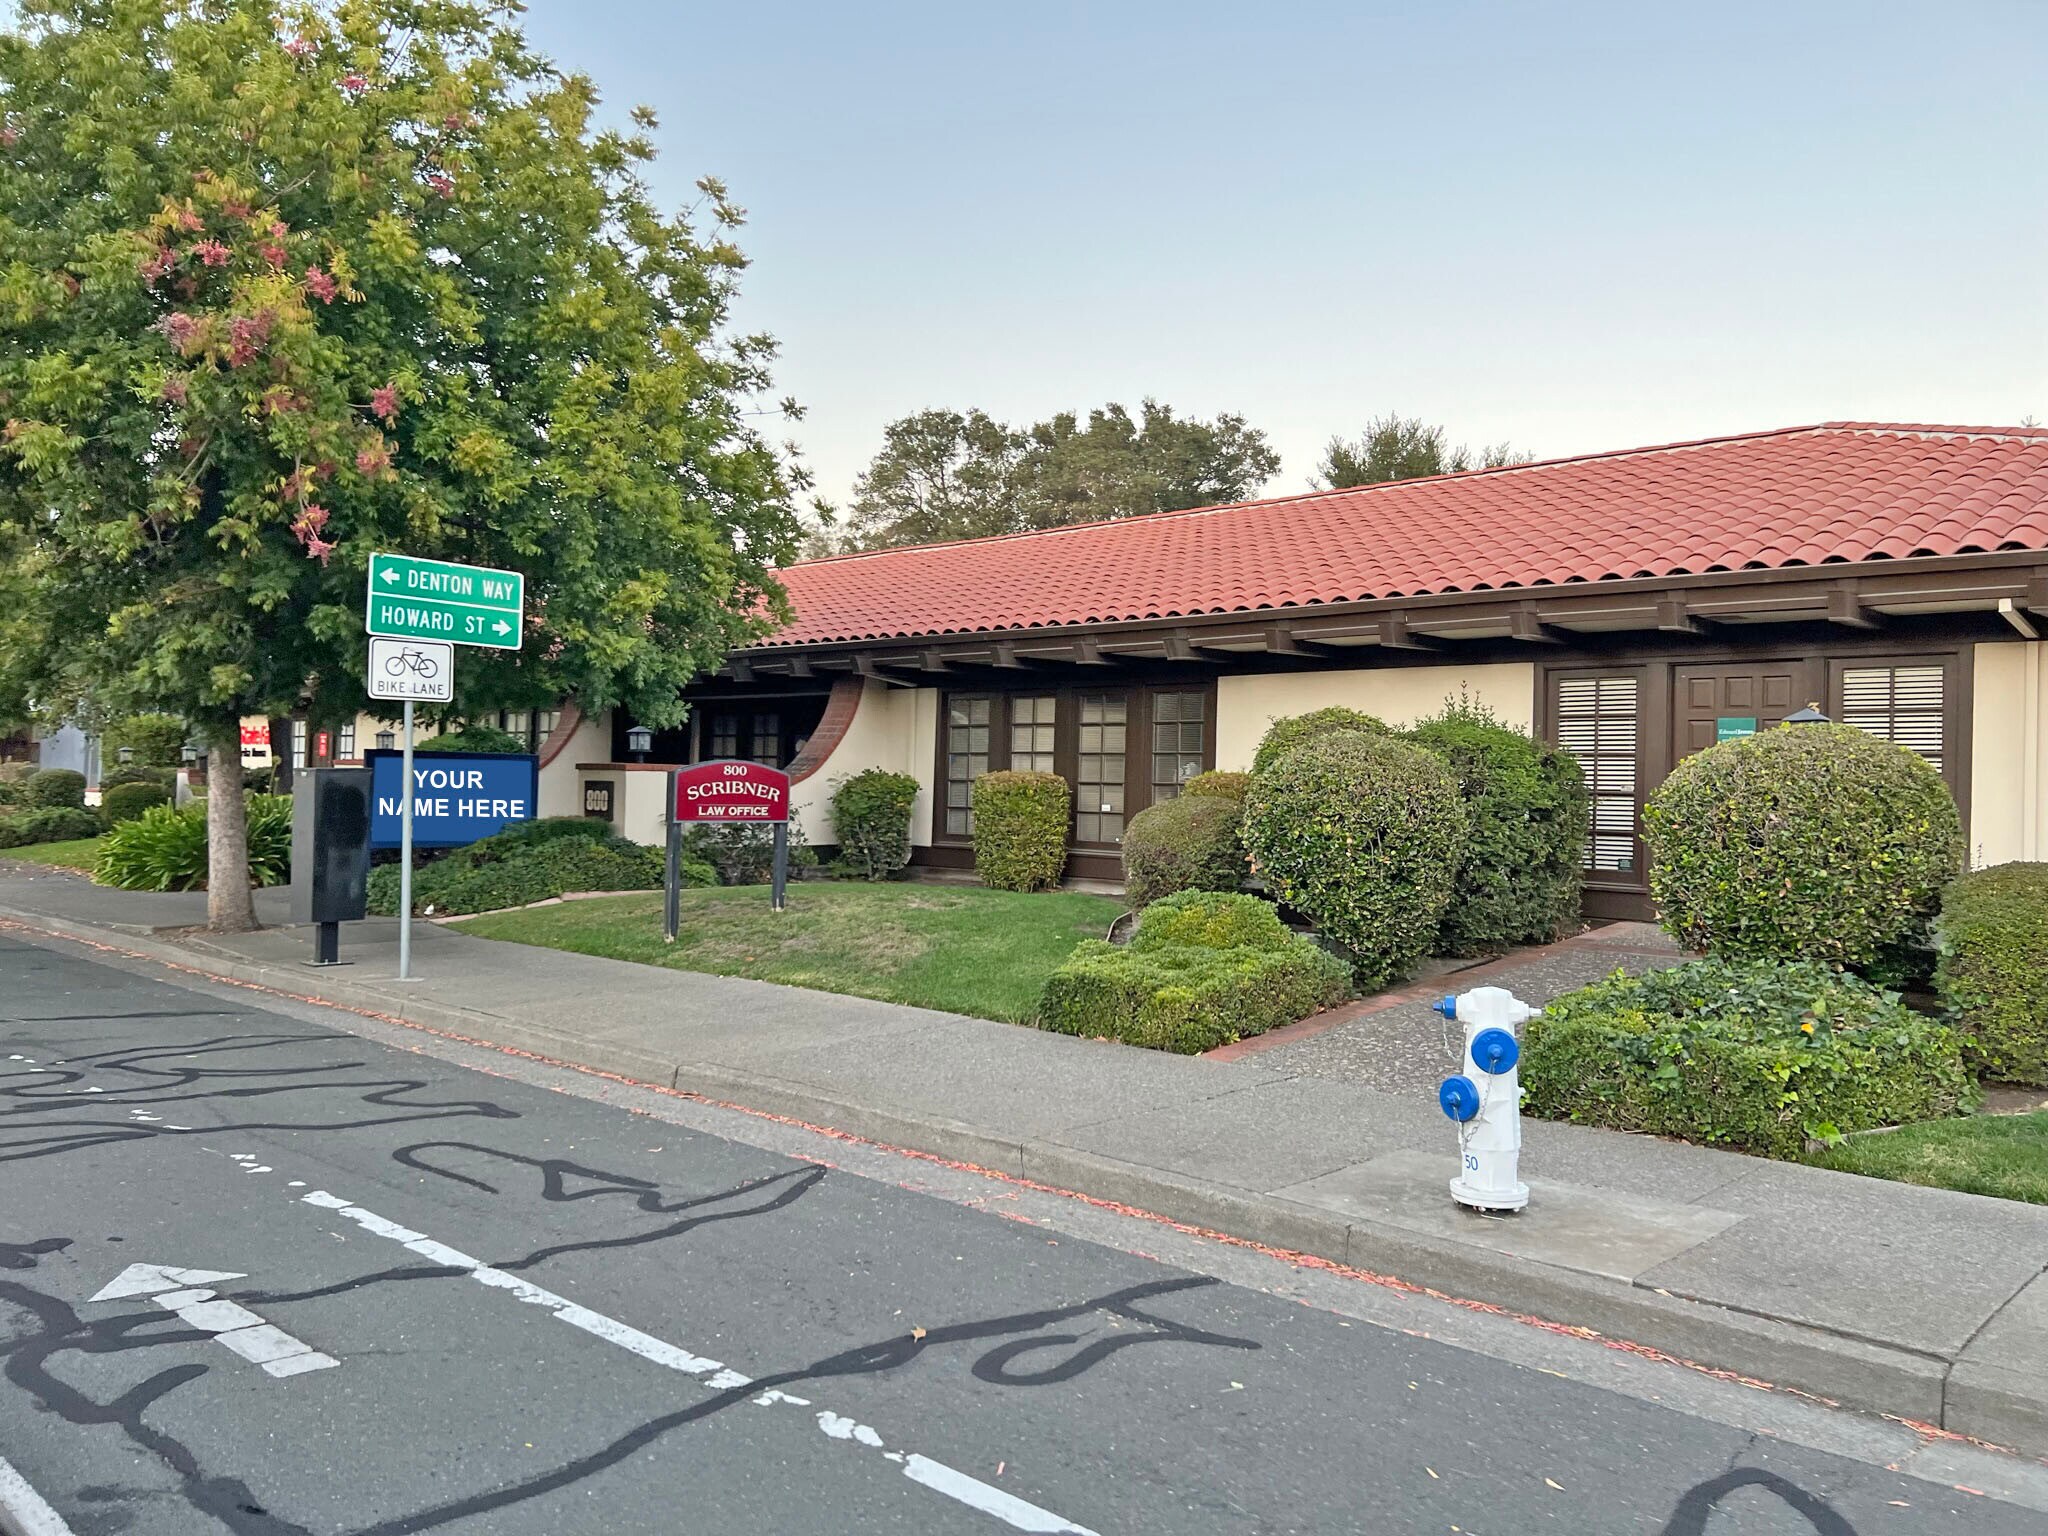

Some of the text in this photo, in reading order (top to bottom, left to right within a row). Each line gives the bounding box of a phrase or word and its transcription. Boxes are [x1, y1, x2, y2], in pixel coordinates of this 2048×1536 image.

[408, 569, 514, 600] DENTON WAY
[381, 605, 485, 634] HOWARD ST
[378, 681, 444, 695] BIKE LANE
[413, 770, 483, 789] YOUR
[723, 765, 747, 776] 800
[586, 790, 608, 811] 800
[687, 780, 780, 802] SCRIBNER
[458, 799, 524, 818] HERE
[698, 806, 769, 816] LAW OFFICE
[1465, 1154, 1478, 1171] 50
